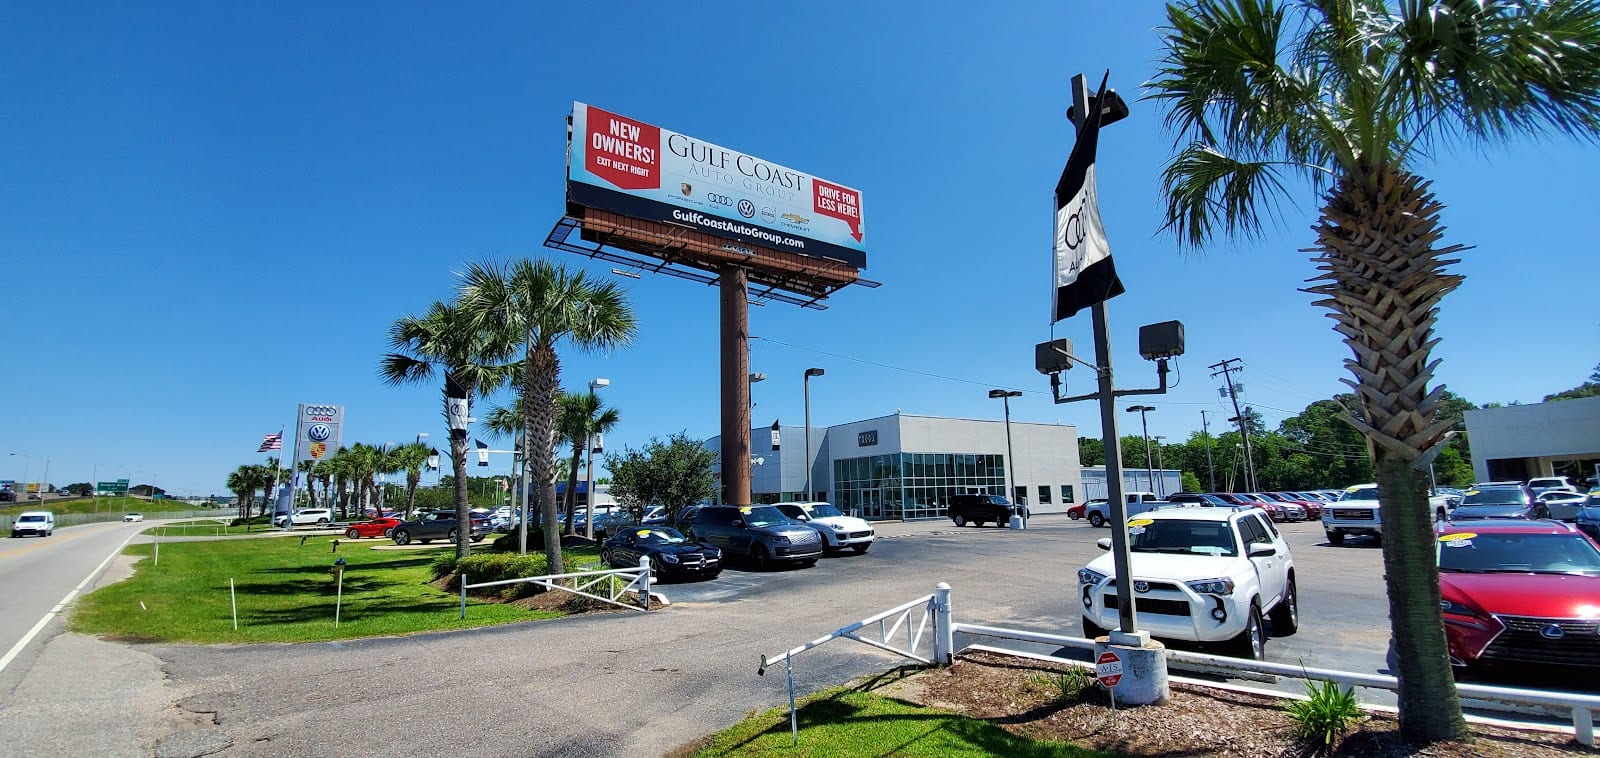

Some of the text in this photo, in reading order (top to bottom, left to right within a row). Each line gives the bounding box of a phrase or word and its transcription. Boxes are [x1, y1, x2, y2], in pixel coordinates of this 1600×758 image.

[610, 118, 640, 142] NEW
[592, 132, 655, 164] OWNERS!
[596, 156, 650, 178] EXIT NEXT RIGHT
[668, 134, 805, 191] GULF COAST
[689, 163, 794, 201] AUTO GROUP
[818, 185, 856, 206] DRIVE FOR
[818, 196, 858, 218] LESS HERE!
[672, 210, 805, 248] GulfCoastAutoGroup.com
[780, 222, 810, 233] CHEVROLET
